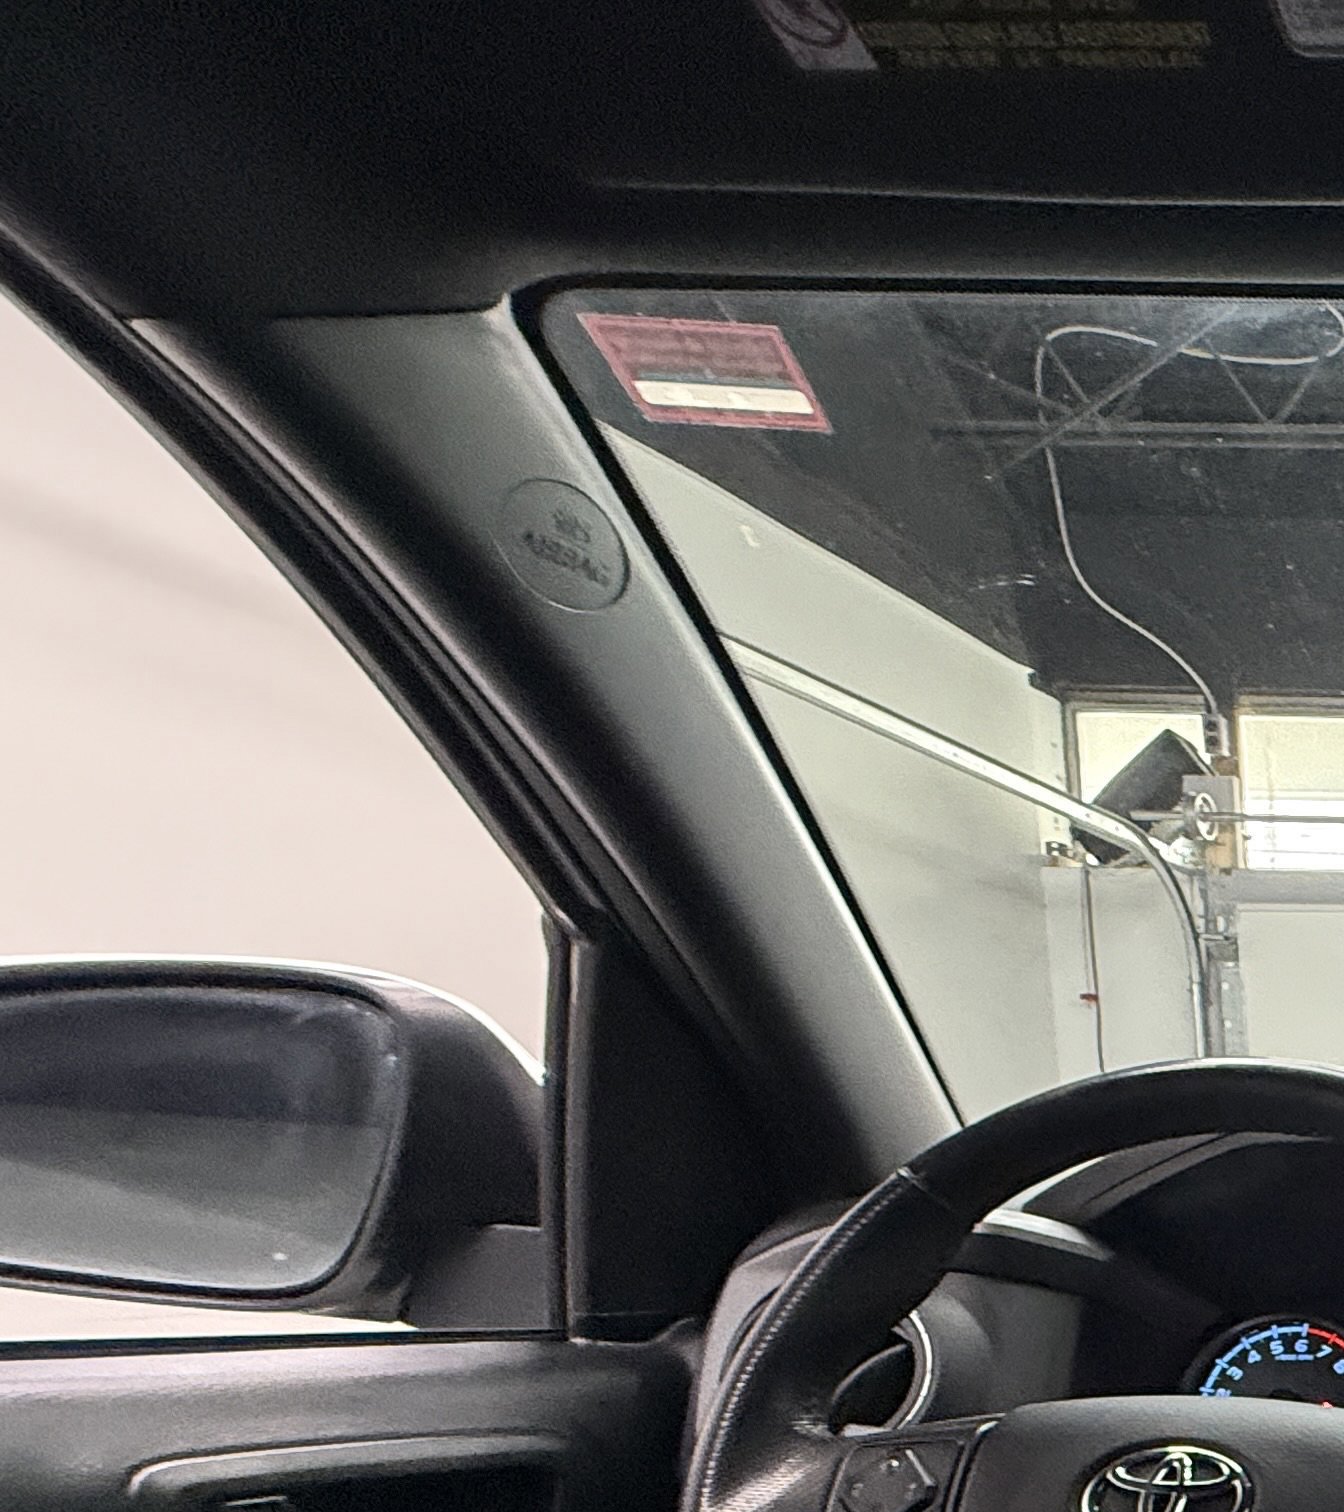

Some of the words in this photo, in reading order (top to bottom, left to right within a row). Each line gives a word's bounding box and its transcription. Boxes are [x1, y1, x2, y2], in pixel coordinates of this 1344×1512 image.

[1269, 1340, 1284, 1355] 5
[1295, 1339, 1309, 1353] 6
[1315, 1344, 1333, 1358] 7
[1247, 1350, 1262, 1364] 4
[1226, 1366, 1244, 1381] 3
